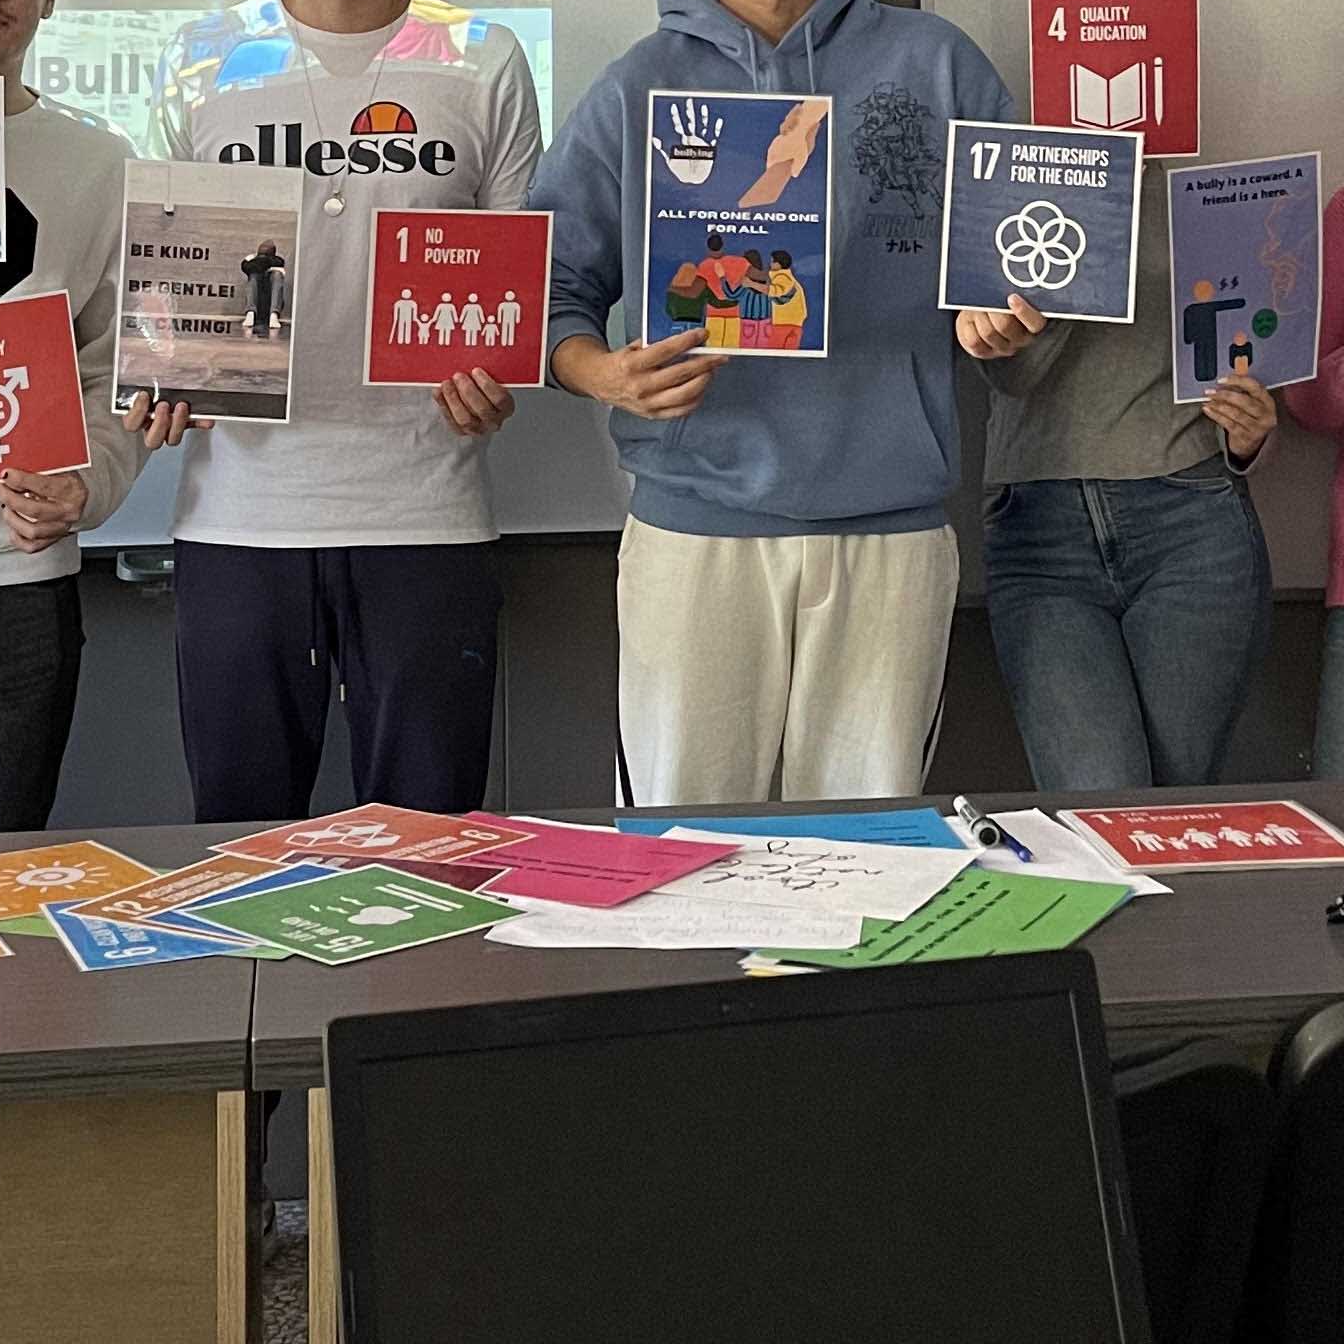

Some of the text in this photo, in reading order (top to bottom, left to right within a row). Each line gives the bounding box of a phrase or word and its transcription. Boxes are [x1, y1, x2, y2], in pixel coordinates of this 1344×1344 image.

[1079, 6, 1130, 23] QUALITY
[1048, 7, 1067, 42] 4
[1080, 25, 1147, 42] EDUCATION
[219, 123, 456, 177] ellesse
[1011, 144, 1109, 167] PARTNERSHIPS
[970, 141, 1001, 181] 17
[1010, 167, 1107, 188] FOR THE GOALS
[1185, 181, 1195, 192] A
[1197, 176, 1225, 192] bully
[1227, 175, 1238, 187] is
[1239, 177, 1247, 186] a
[1295, 168, 1304, 179] A
[1202, 192, 1238, 206] friend
[1239, 190, 1251, 202] is
[1251, 192, 1259, 200] a
[657, 209, 820, 223] ALL FOR ONE AND ONE
[425, 227, 444, 244] NO
[707, 224, 769, 234] FOR ALL
[131, 243, 210, 260] BE KIND!
[396, 227, 409, 263] 1
[885, 239, 924, 254] ナルト
[424, 247, 480, 265] POVERTY
[102, 899, 160, 916] 12
[314, 936, 376, 953] 15
